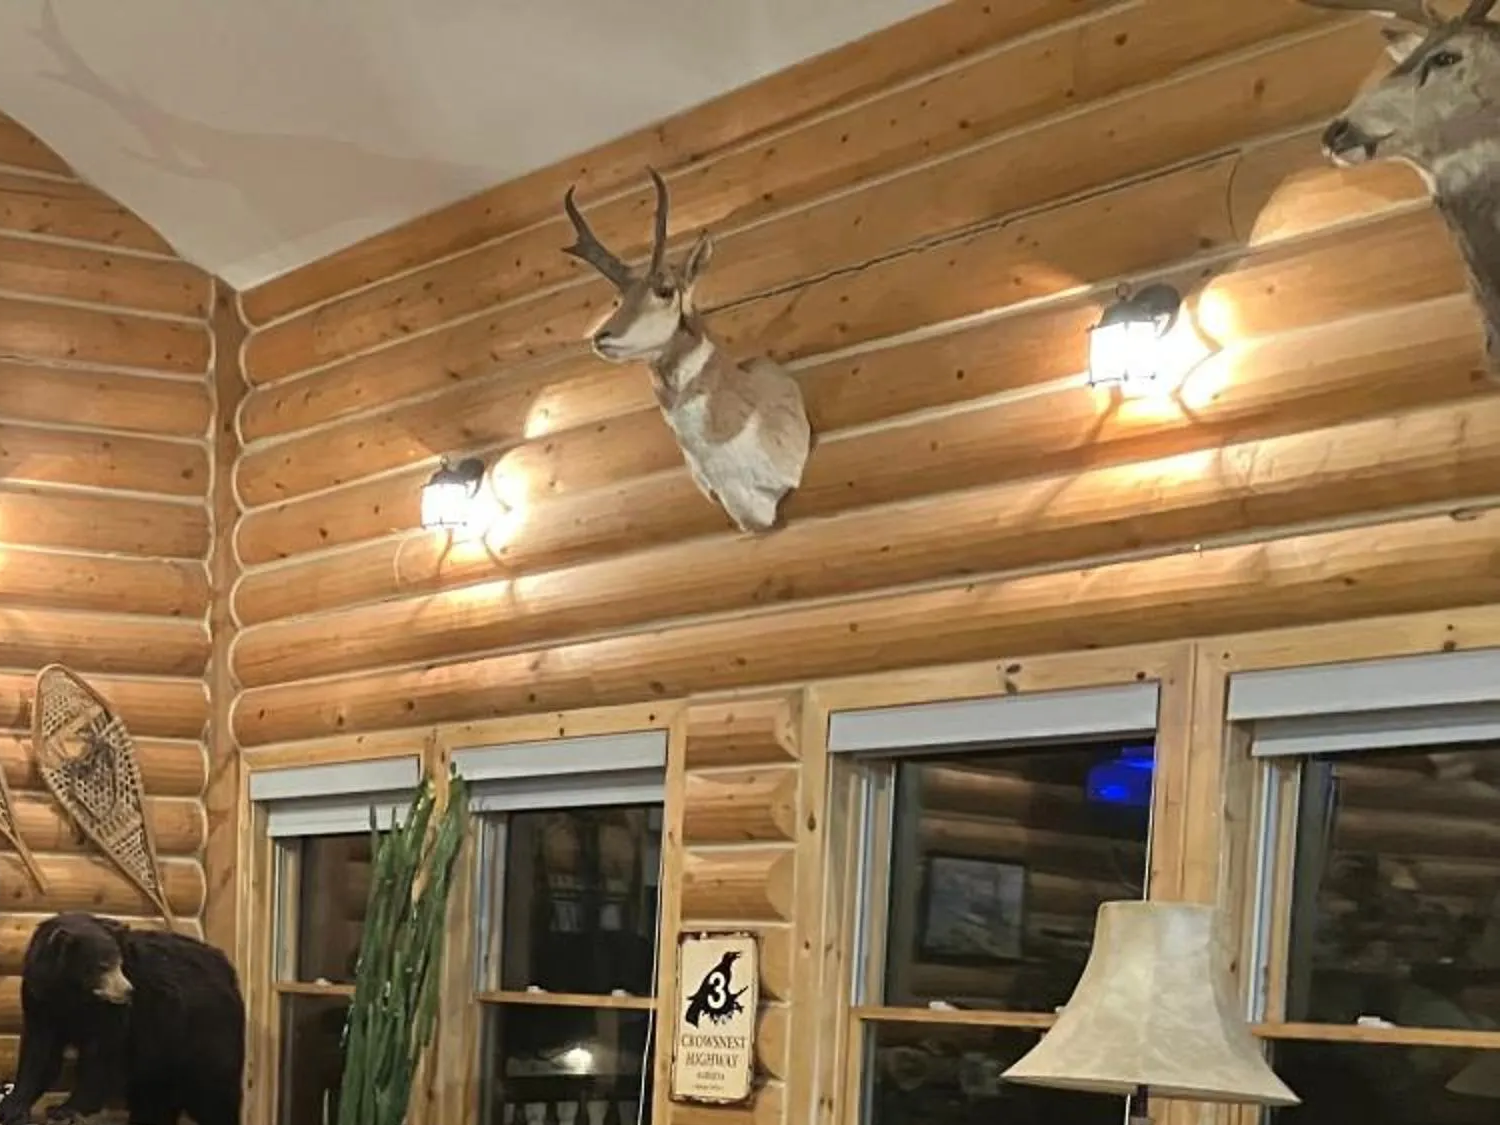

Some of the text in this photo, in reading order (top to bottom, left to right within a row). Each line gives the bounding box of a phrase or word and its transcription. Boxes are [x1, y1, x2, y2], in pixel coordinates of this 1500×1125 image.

[707, 971, 727, 1010] 3
[681, 1034, 747, 1049] CROWSNEST
[685, 1052, 739, 1068] HIGHWAY
